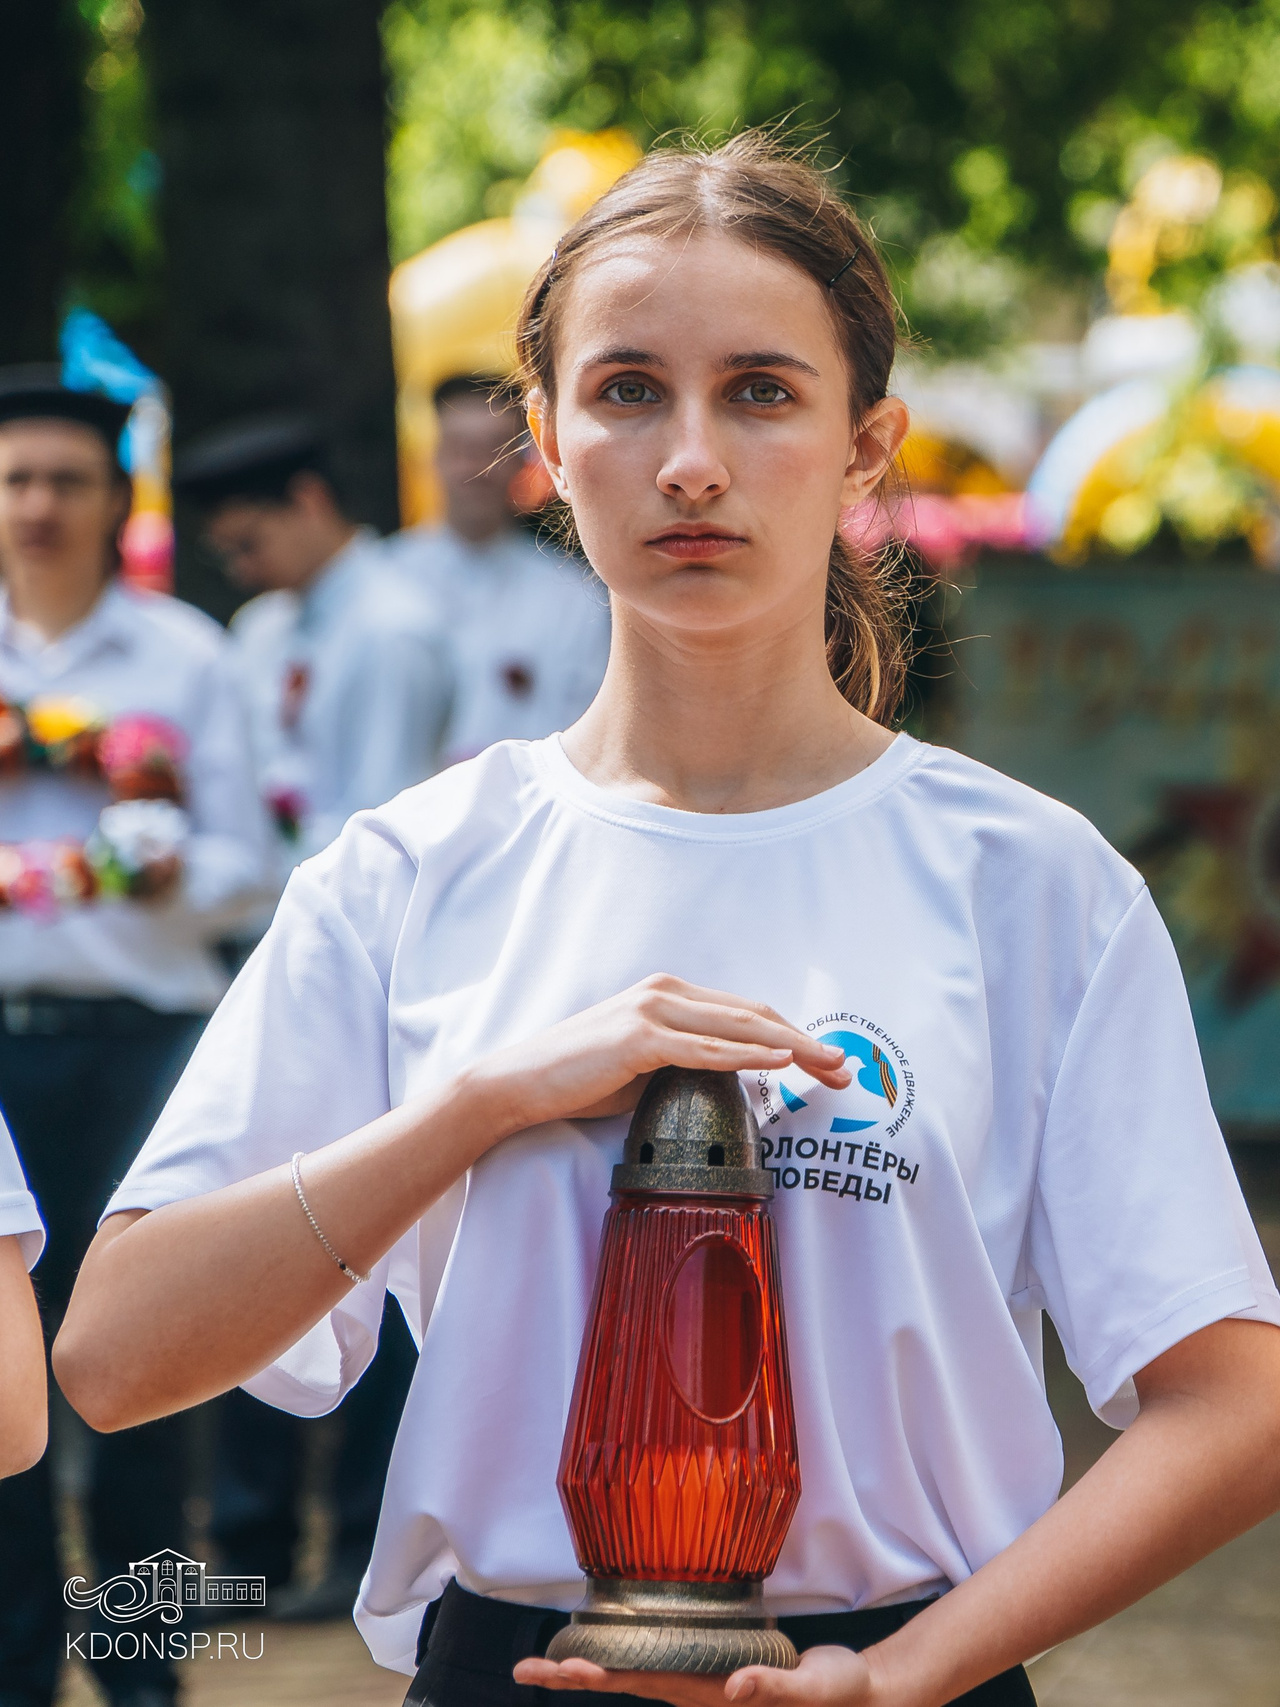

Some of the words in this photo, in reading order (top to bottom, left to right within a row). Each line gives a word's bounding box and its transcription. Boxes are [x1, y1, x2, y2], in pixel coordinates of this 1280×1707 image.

[806, 1011, 910, 1067] ОБЩЕСТВЕННОЕ
[884, 1069, 917, 1138] ДВИЖЕНИЕ
[760, 1136, 921, 1185] ОЛОНТЁРЫ
